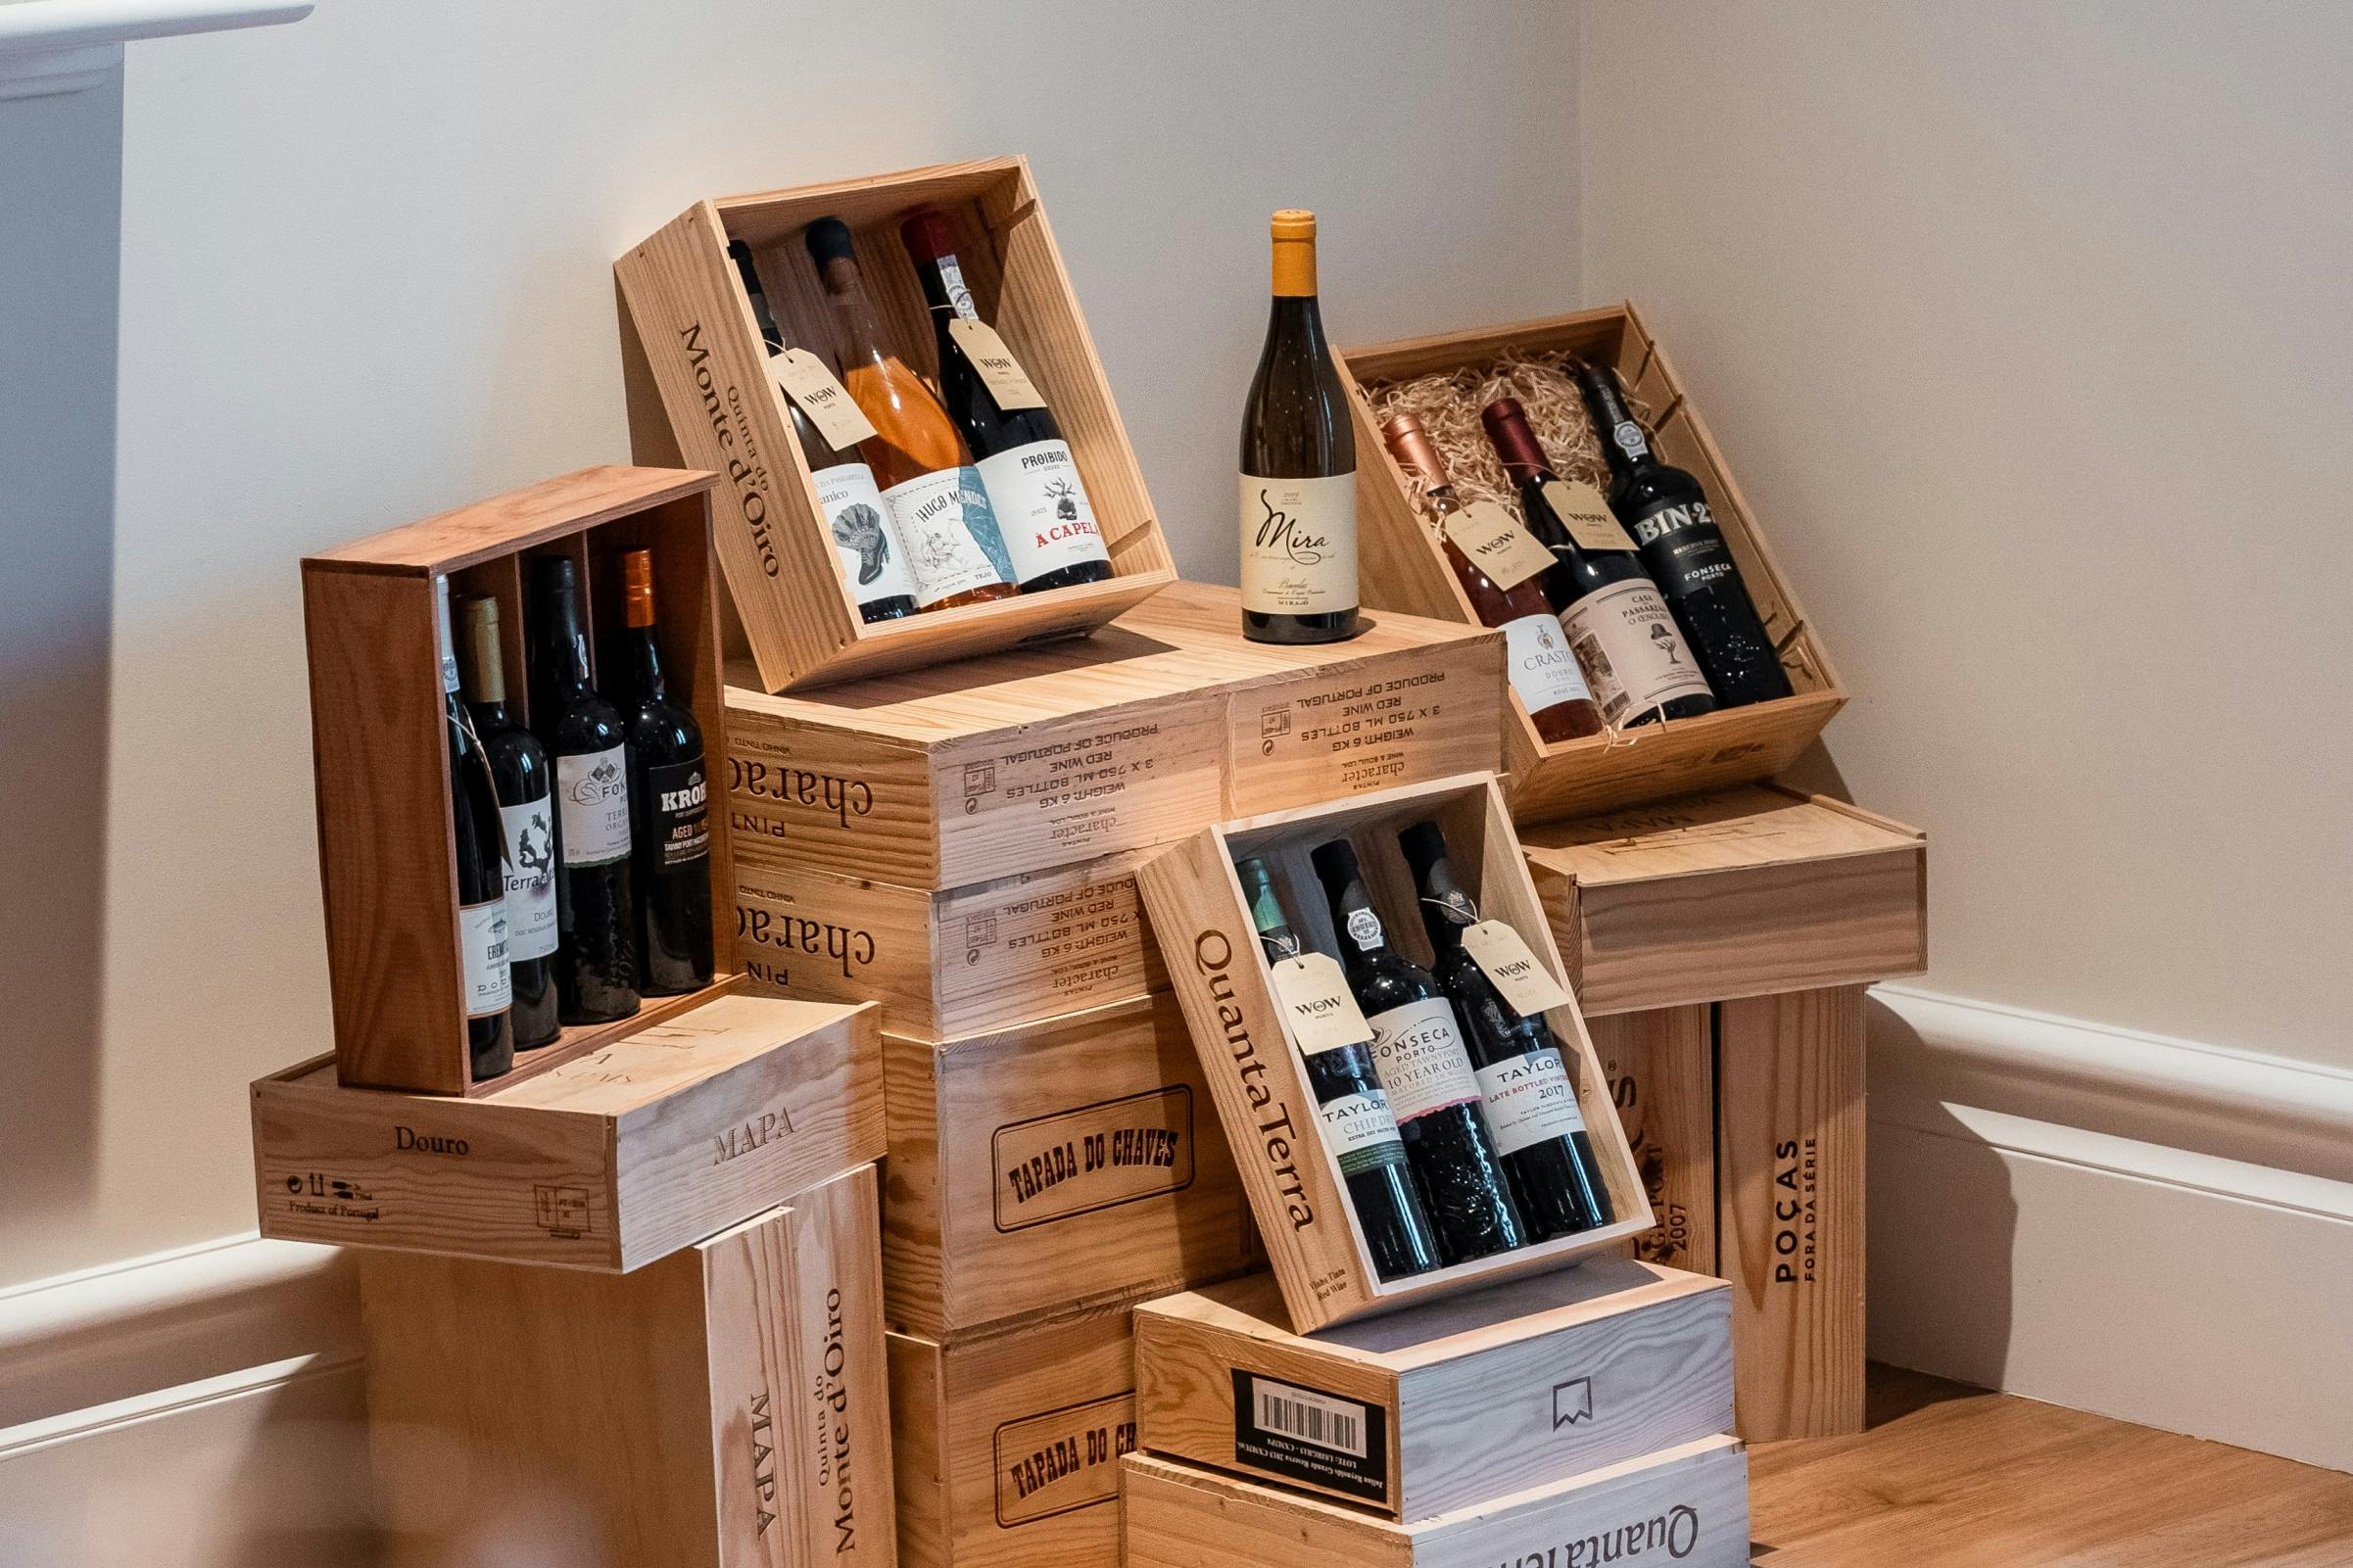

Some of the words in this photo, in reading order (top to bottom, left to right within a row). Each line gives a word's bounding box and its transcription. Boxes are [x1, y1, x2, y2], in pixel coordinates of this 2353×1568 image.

[980, 358, 1011, 368] WOW
[804, 386, 837, 404] WOW
[680, 319, 734, 451] Monte
[728, 456, 779, 578] d'Oiro
[728, 386, 756, 458] Quinta
[755, 466, 769, 492] do
[1022, 451, 1068, 469] PROIBIDO
[916, 495, 948, 523] HUGO
[1568, 512, 1608, 523] WOW
[1256, 489, 1329, 565] Mira
[1634, 504, 1693, 546] BIN
[1475, 530, 1515, 555] WOW
[1684, 563, 1732, 582] FONSECA
[1366, 686, 1382, 696] OF
[1385, 672, 1445, 691] PRODUCE
[1296, 689, 1363, 709] PORTUGAL
[1376, 696, 1402, 710] RED
[1342, 702, 1373, 717] WINE
[1389, 710, 1415, 726] 750
[1418, 707, 1428, 718] X
[1432, 704, 1441, 715] 3
[1301, 721, 1361, 741] BOTTLES
[1366, 717, 1383, 729] ML
[1074, 738, 1093, 751] OF
[1095, 724, 1158, 746] PRODUCE
[1353, 738, 1363, 748] 6
[1365, 728, 1414, 745] WEIGHT:
[1001, 743, 1072, 766] PORTUGAL
[1331, 740, 1350, 752] KG
[1049, 758, 1083, 773] WINE
[1086, 751, 1113, 765] RED
[1131, 762, 1140, 773] X
[1144, 758, 1153, 769] 3
[1073, 773, 1094, 784] ML
[1099, 765, 1126, 780] 750
[1342, 761, 1405, 783] character
[602, 783, 627, 798] FON
[728, 757, 874, 829] charac
[1006, 778, 1069, 799] BOTTLES
[1062, 793, 1070, 803] 6
[1078, 782, 1125, 802] WEIGHT:
[1039, 796, 1058, 809] KG
[672, 825, 693, 840] AGED
[1050, 817, 1117, 840] character
[1077, 886, 1095, 900] OF
[1098, 878, 1138, 895] DUCE
[1003, 893, 1074, 916] PORTUGAL
[1088, 899, 1114, 914] RED
[1051, 907, 1084, 923] WINE
[1100, 914, 1128, 927] 750
[1077, 921, 1095, 932] ML
[1008, 927, 1071, 949] BOTTLES
[1076, 929, 1128, 949] WEIGHT:
[1041, 945, 1061, 958] KG
[1065, 943, 1073, 953] 6
[747, 961, 789, 986] PIN
[1052, 965, 1119, 988] character
[1494, 960, 1531, 979] WOW
[1295, 996, 1341, 1015] WOW
[1396, 1045, 1435, 1063] PORTO
[1387, 1077, 1402, 1089] 10
[1405, 1063, 1440, 1082] YEAR
[1442, 1058, 1464, 1070] OLD
[1489, 1089, 1511, 1103] LATE
[1512, 1077, 1548, 1095] BOTTLED
[1538, 1084, 1564, 1100] 2017
[395, 1126, 470, 1156] Douro
[712, 1107, 796, 1166] MAPA
[1009, 1142, 1078, 1204] TAPADA
[1084, 1133, 1105, 1172] DO
[1113, 1128, 1178, 1167] CHAVES
[1801, 1138, 1817, 1194] SÉRIE
[1775, 1140, 1802, 1283] POÇAS
[1804, 1201, 1817, 1225] DA
[1669, 1204, 1687, 1252] 2007
[1804, 1231, 1817, 1282] FORA
[824, 1288, 848, 1413] d'Oiro
[814, 1375, 825, 1402] do
[817, 1410, 831, 1487] Quinta
[750, 1393, 777, 1542] MAPA
[1010, 1436, 1080, 1499] TAPADA
[1086, 1427, 1107, 1466] DO
[1116, 1422, 1137, 1459] CH
[834, 1422, 856, 1555] Monte
